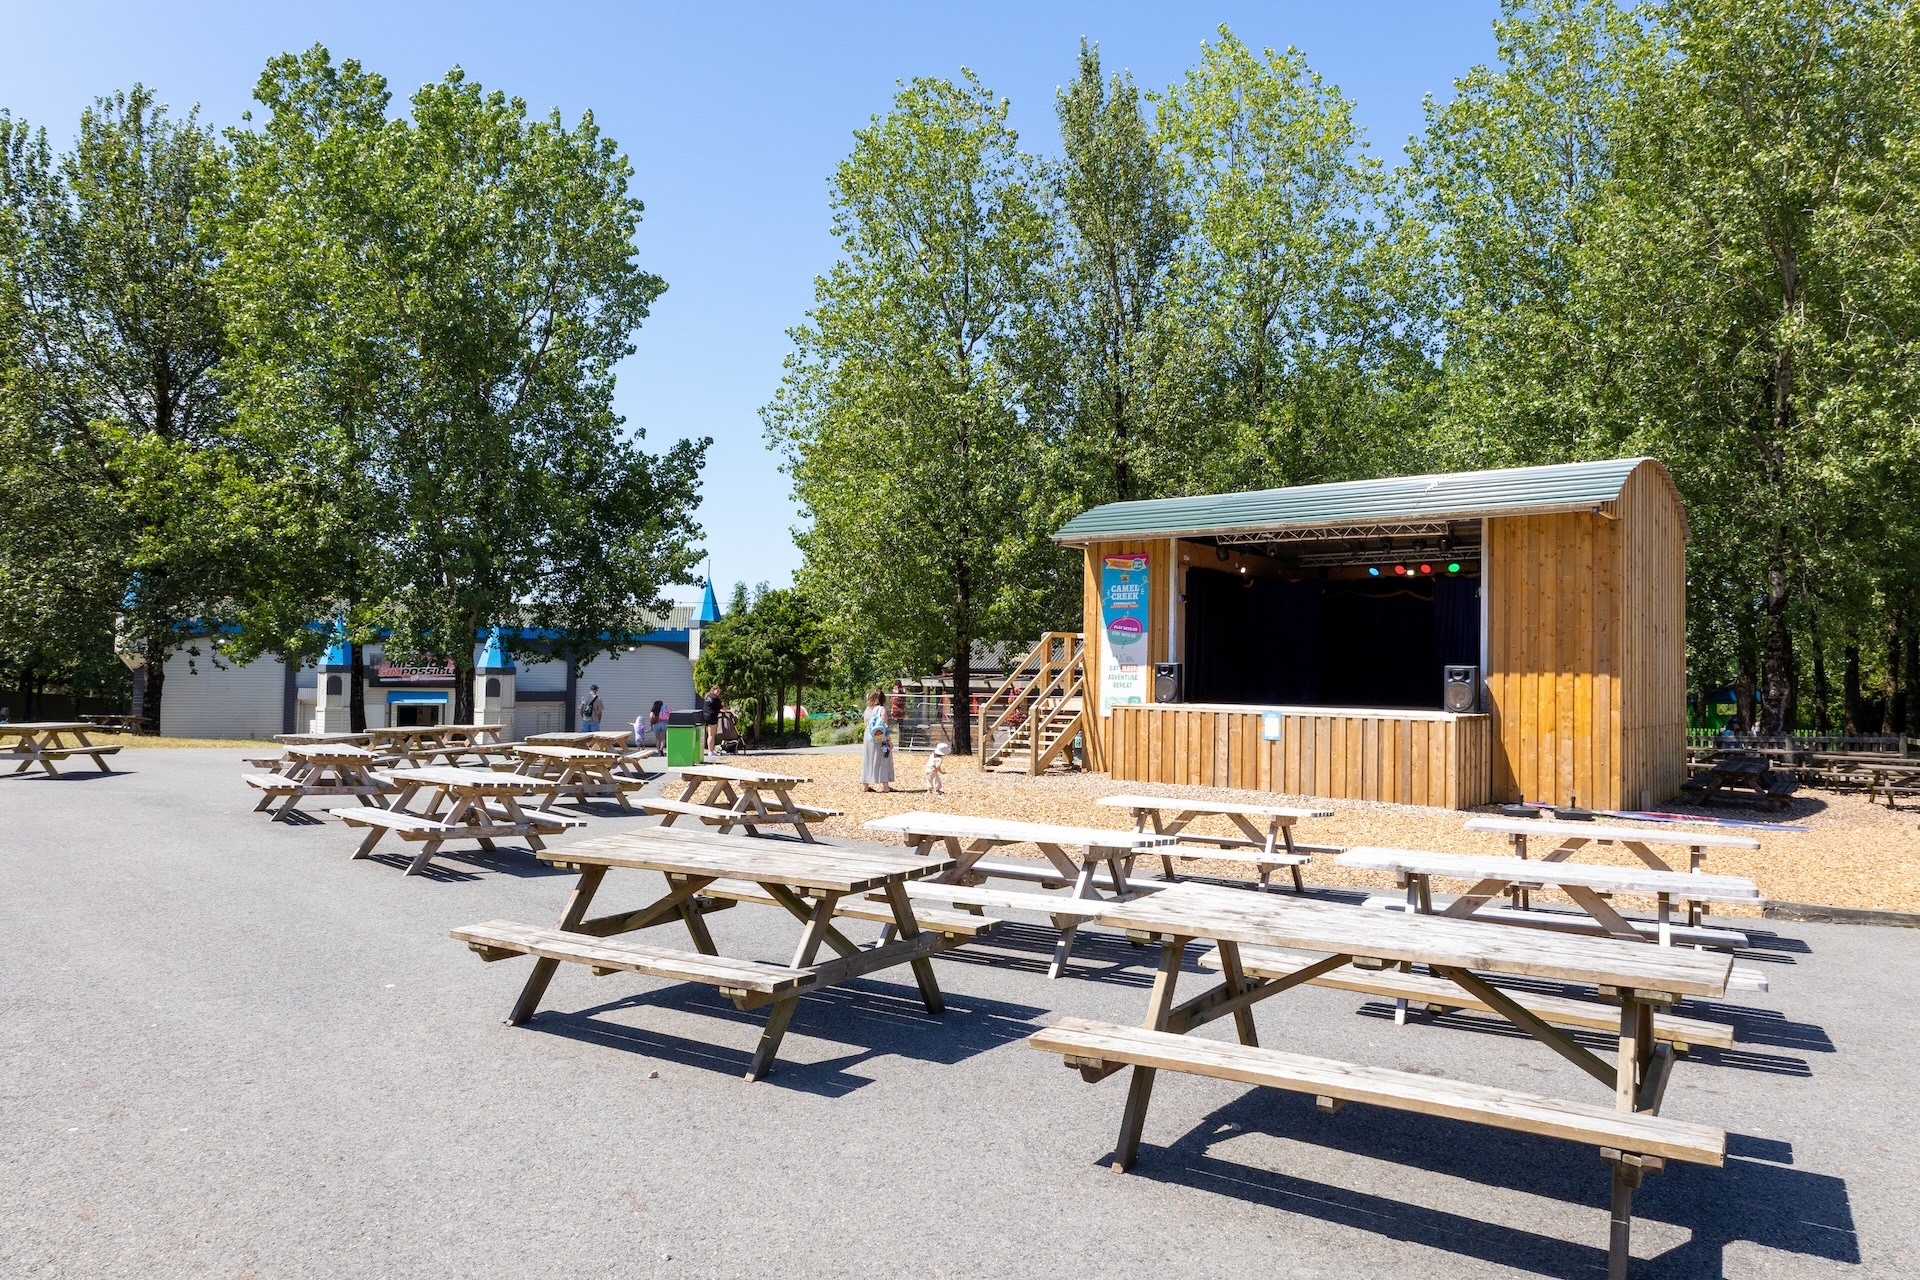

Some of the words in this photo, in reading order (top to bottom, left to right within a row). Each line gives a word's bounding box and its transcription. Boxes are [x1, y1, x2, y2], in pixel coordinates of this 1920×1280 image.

[1111, 584, 1139, 592] CAMEL
[1111, 592, 1138, 600] CREEK
[390, 660, 449, 668] MISO
